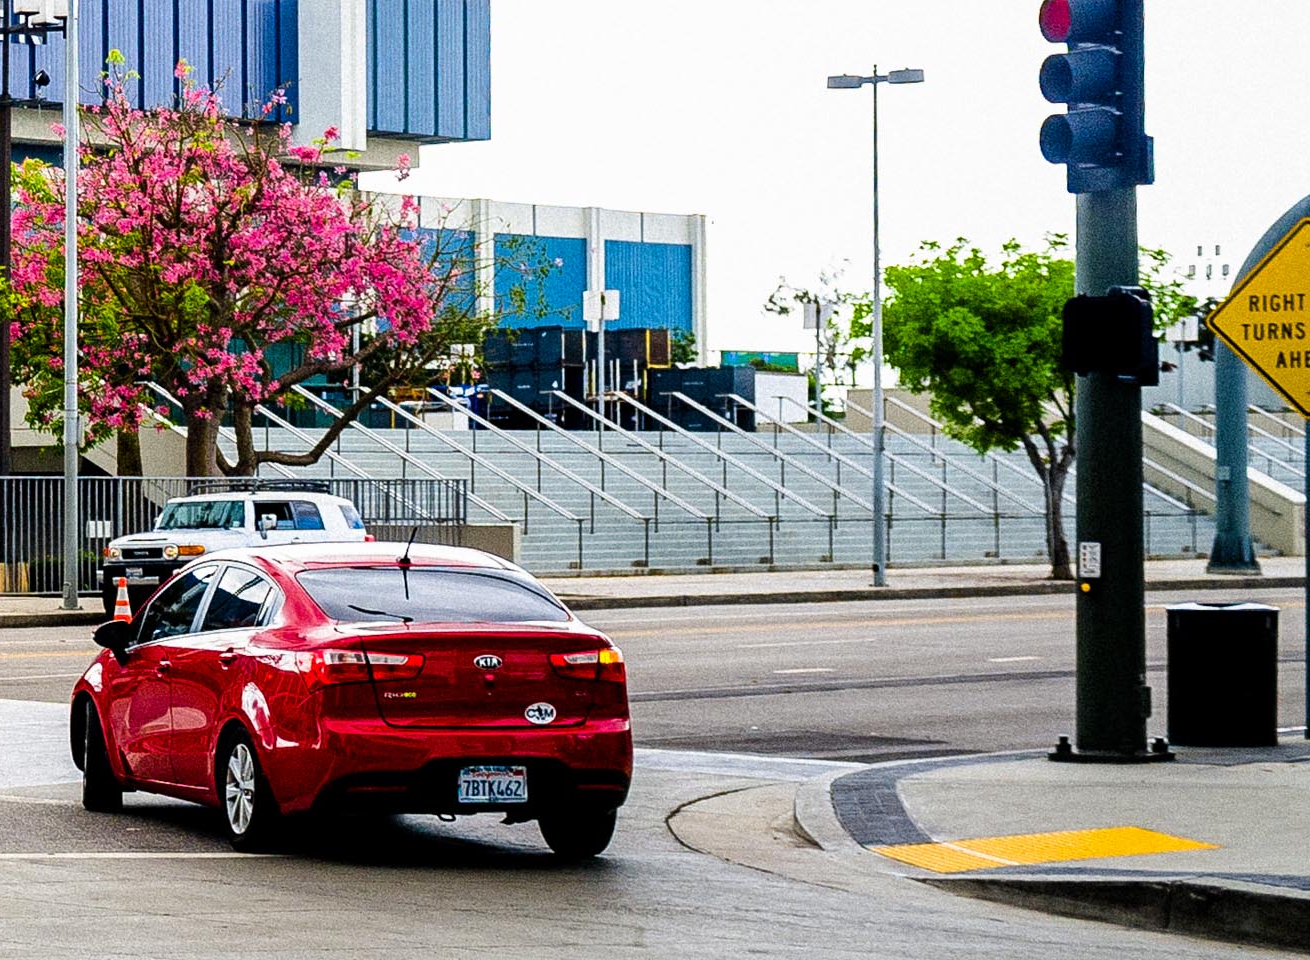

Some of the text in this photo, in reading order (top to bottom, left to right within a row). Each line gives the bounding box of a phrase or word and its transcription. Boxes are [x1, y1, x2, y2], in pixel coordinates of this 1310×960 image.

[1248, 293, 1306, 312] RIGHT
[1241, 322, 1306, 340] TURNS
[1275, 350, 1310, 369] AHE
[479, 657, 498, 667] KIA
[462, 780, 523, 797] 7BTK462
